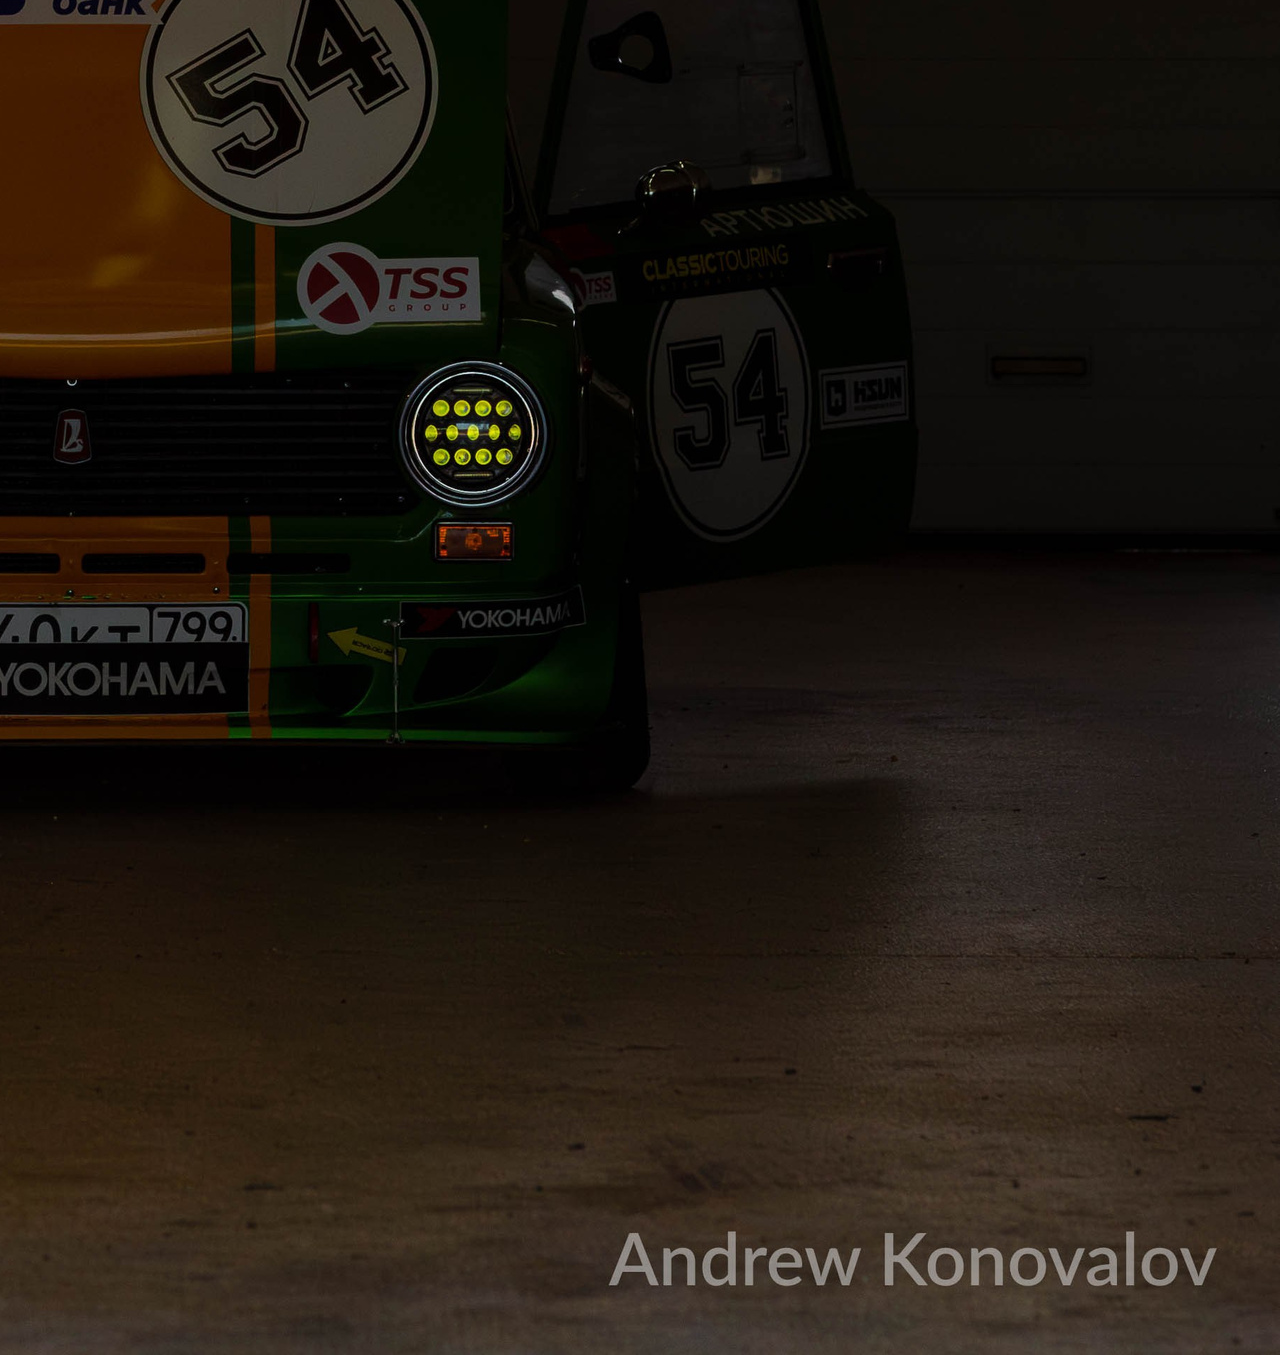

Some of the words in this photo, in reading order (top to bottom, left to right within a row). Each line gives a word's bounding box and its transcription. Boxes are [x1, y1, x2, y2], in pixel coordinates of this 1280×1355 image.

[699, 195, 869, 238] АРТЮШИН
[383, 265, 469, 300] TSS
[585, 275, 612, 295] TSS
[387, 302, 468, 313] GROUP
[667, 328, 791, 472] 54
[853, 376, 902, 404] HSUN
[156, 611, 234, 642] 799
[456, 598, 572, 629] YOKOHAMA
